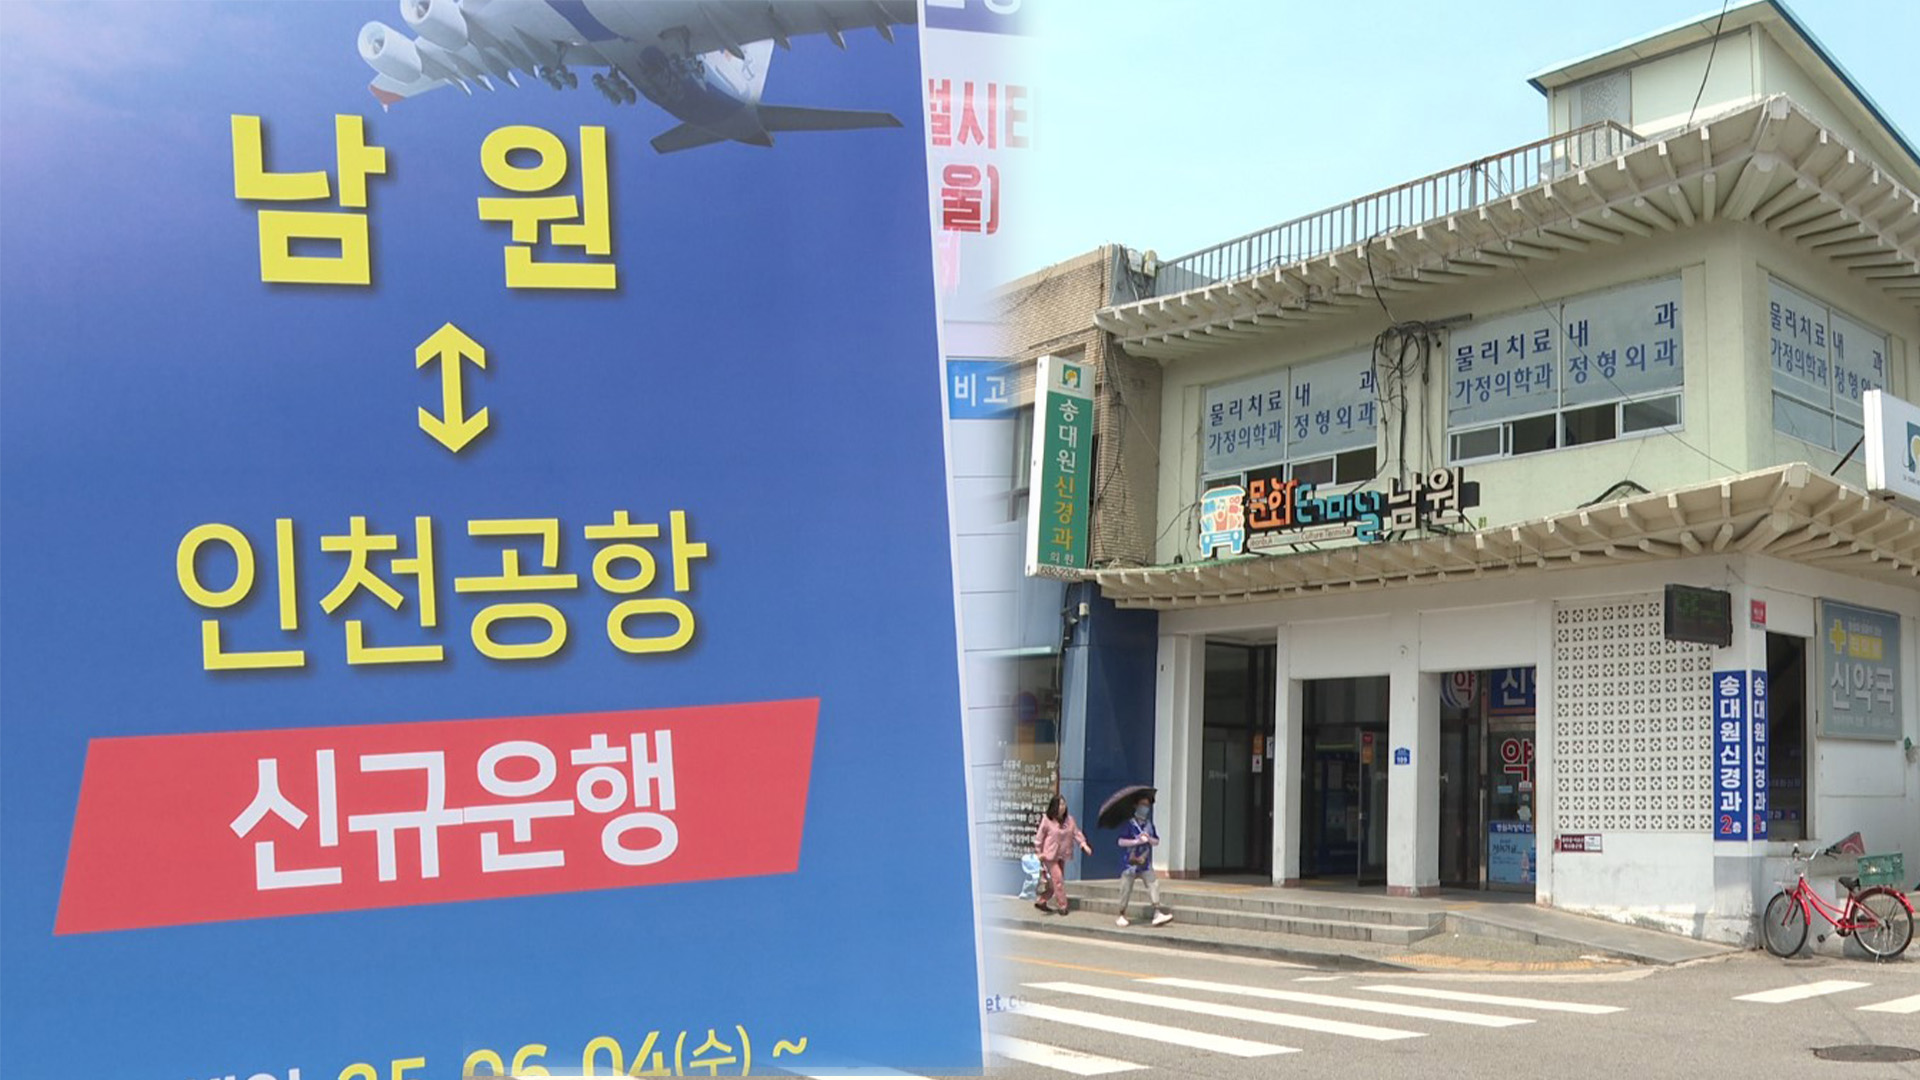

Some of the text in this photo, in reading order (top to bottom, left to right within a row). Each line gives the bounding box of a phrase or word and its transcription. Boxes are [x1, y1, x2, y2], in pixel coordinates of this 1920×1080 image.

[1456, 328, 1552, 373] 물리치료
[1770, 301, 1826, 349] 물리치료
[1455, 338, 1677, 404] 가정의학과 정형외과
[1771, 338, 1827, 387] 가정의학과
[954, 373, 1008, 407] 비고
[1210, 390, 1282, 427] 물리치료
[1209, 400, 1376, 455] 가정의학과 정형외과
[176, 510, 708, 671] 인천공항
[1831, 662, 1895, 714] 신약국
[1719, 675, 1742, 812] 송대원신경과
[1754, 677, 1767, 812] 송대원신경과
[229, 729, 679, 891] 신규운행
